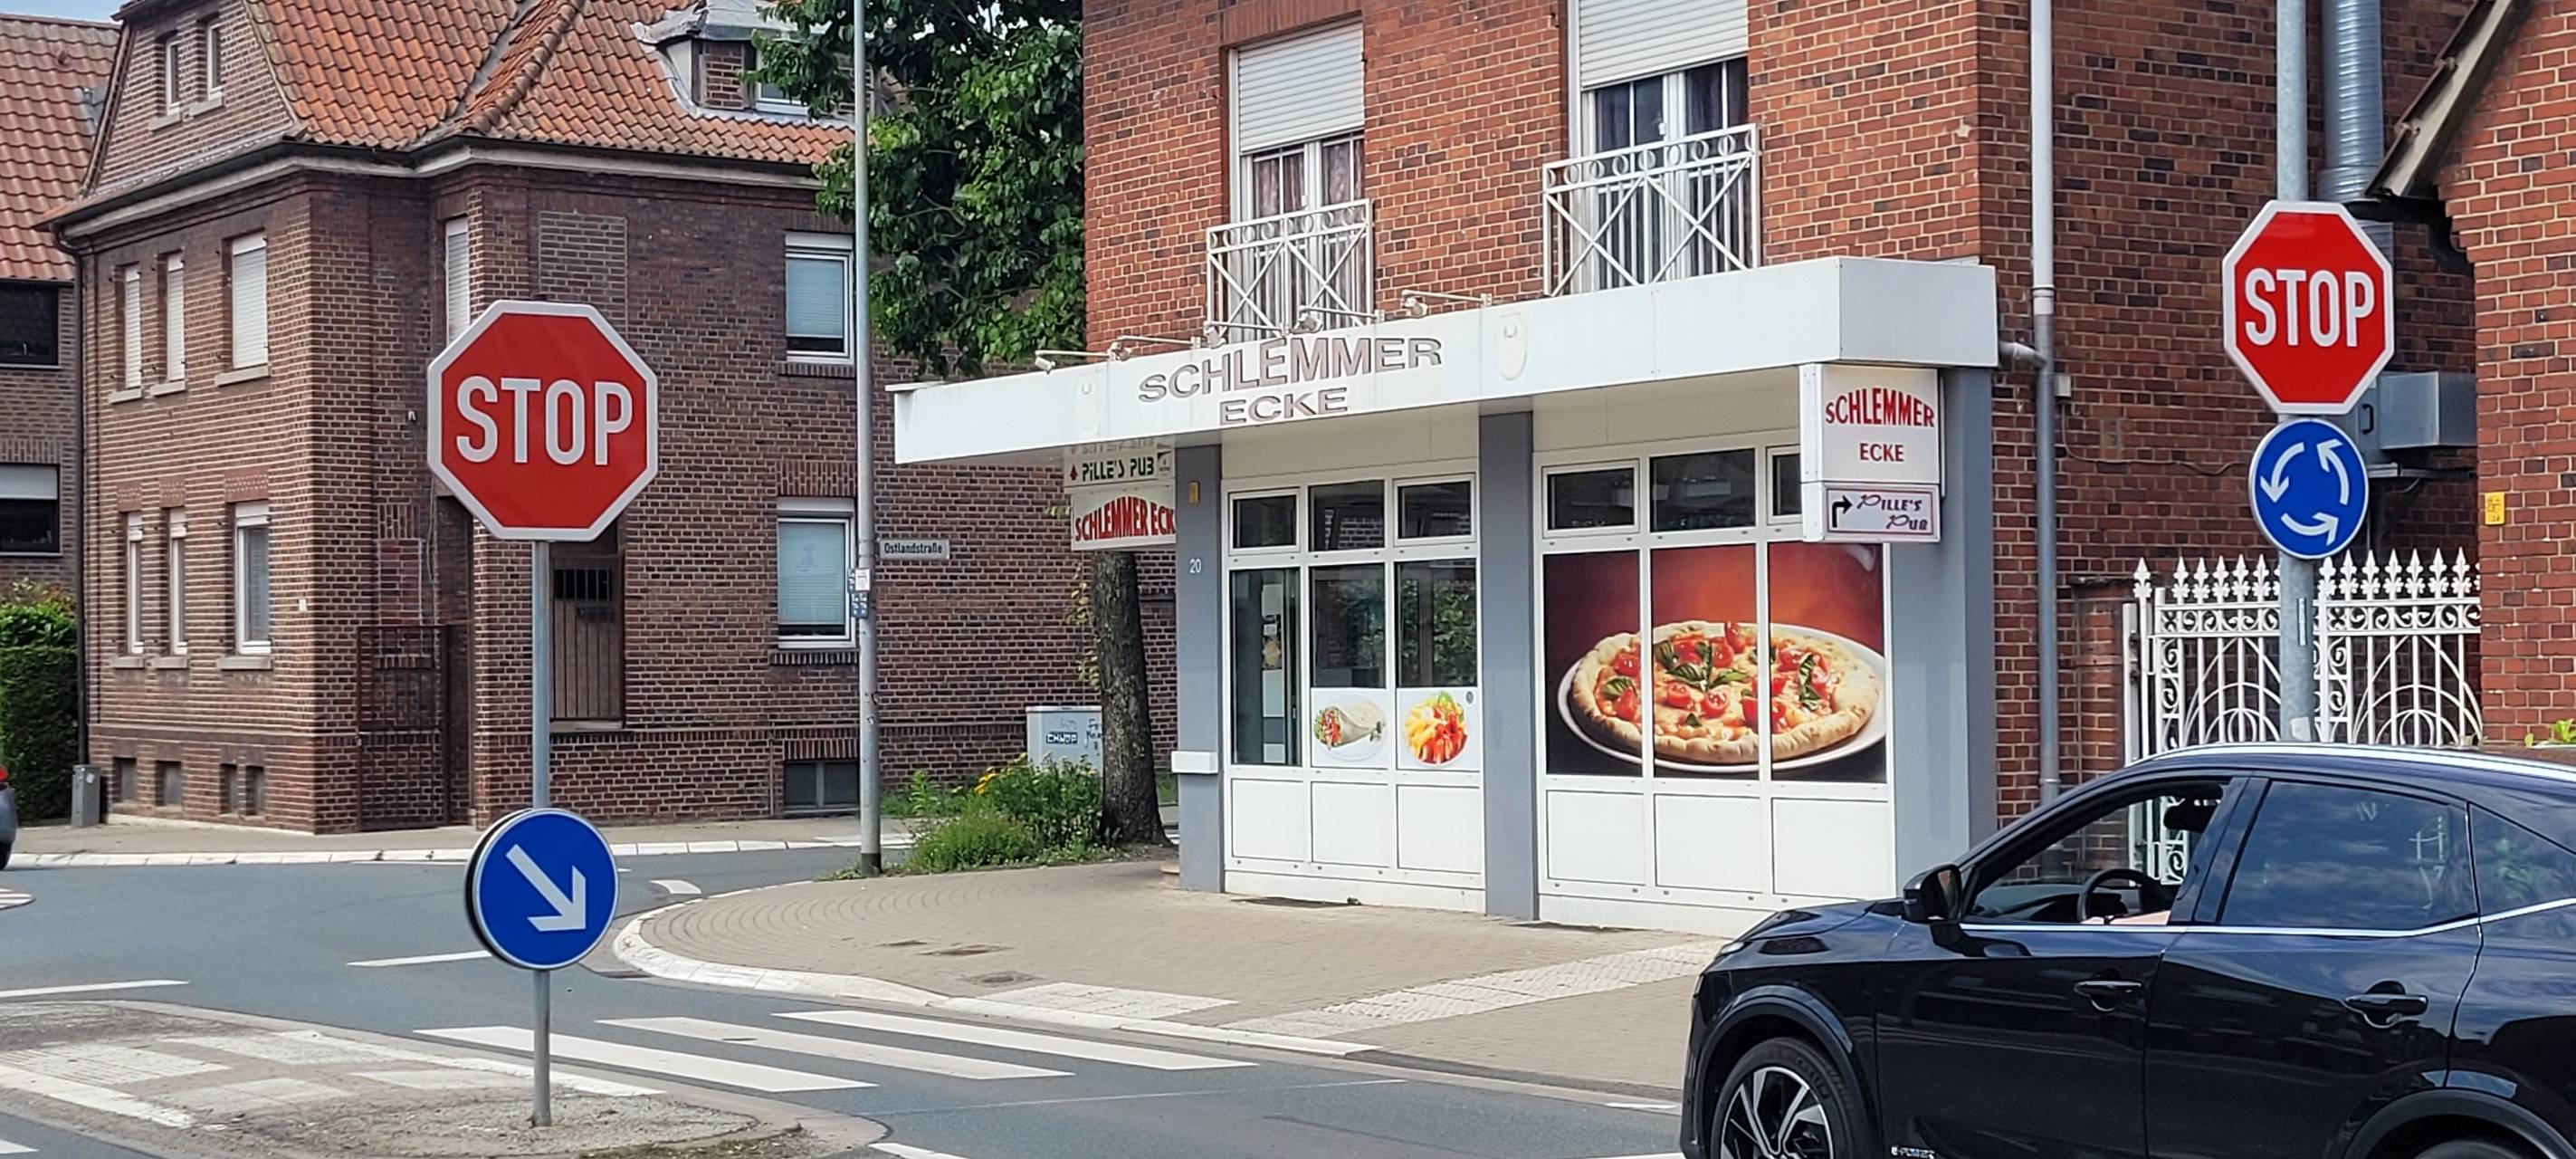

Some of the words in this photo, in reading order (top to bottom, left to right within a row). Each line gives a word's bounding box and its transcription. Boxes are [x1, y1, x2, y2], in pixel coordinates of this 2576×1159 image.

[2245, 267, 2375, 348] STOP
[1139, 337, 1443, 403] SCHLEMMER
[456, 376, 633, 465] STOP
[1219, 388, 1349, 426] ECKE
[1826, 388, 1934, 427] SCHLEMMER
[1130, 456, 1154, 477] PUB
[1860, 443, 1904, 462] ECKE
[1074, 495, 1149, 542] SCHLEMMER
[1150, 501, 1177, 536] ECK
[884, 542, 943, 554] Ostlandstraße
[1189, 558, 1202, 573] 20
